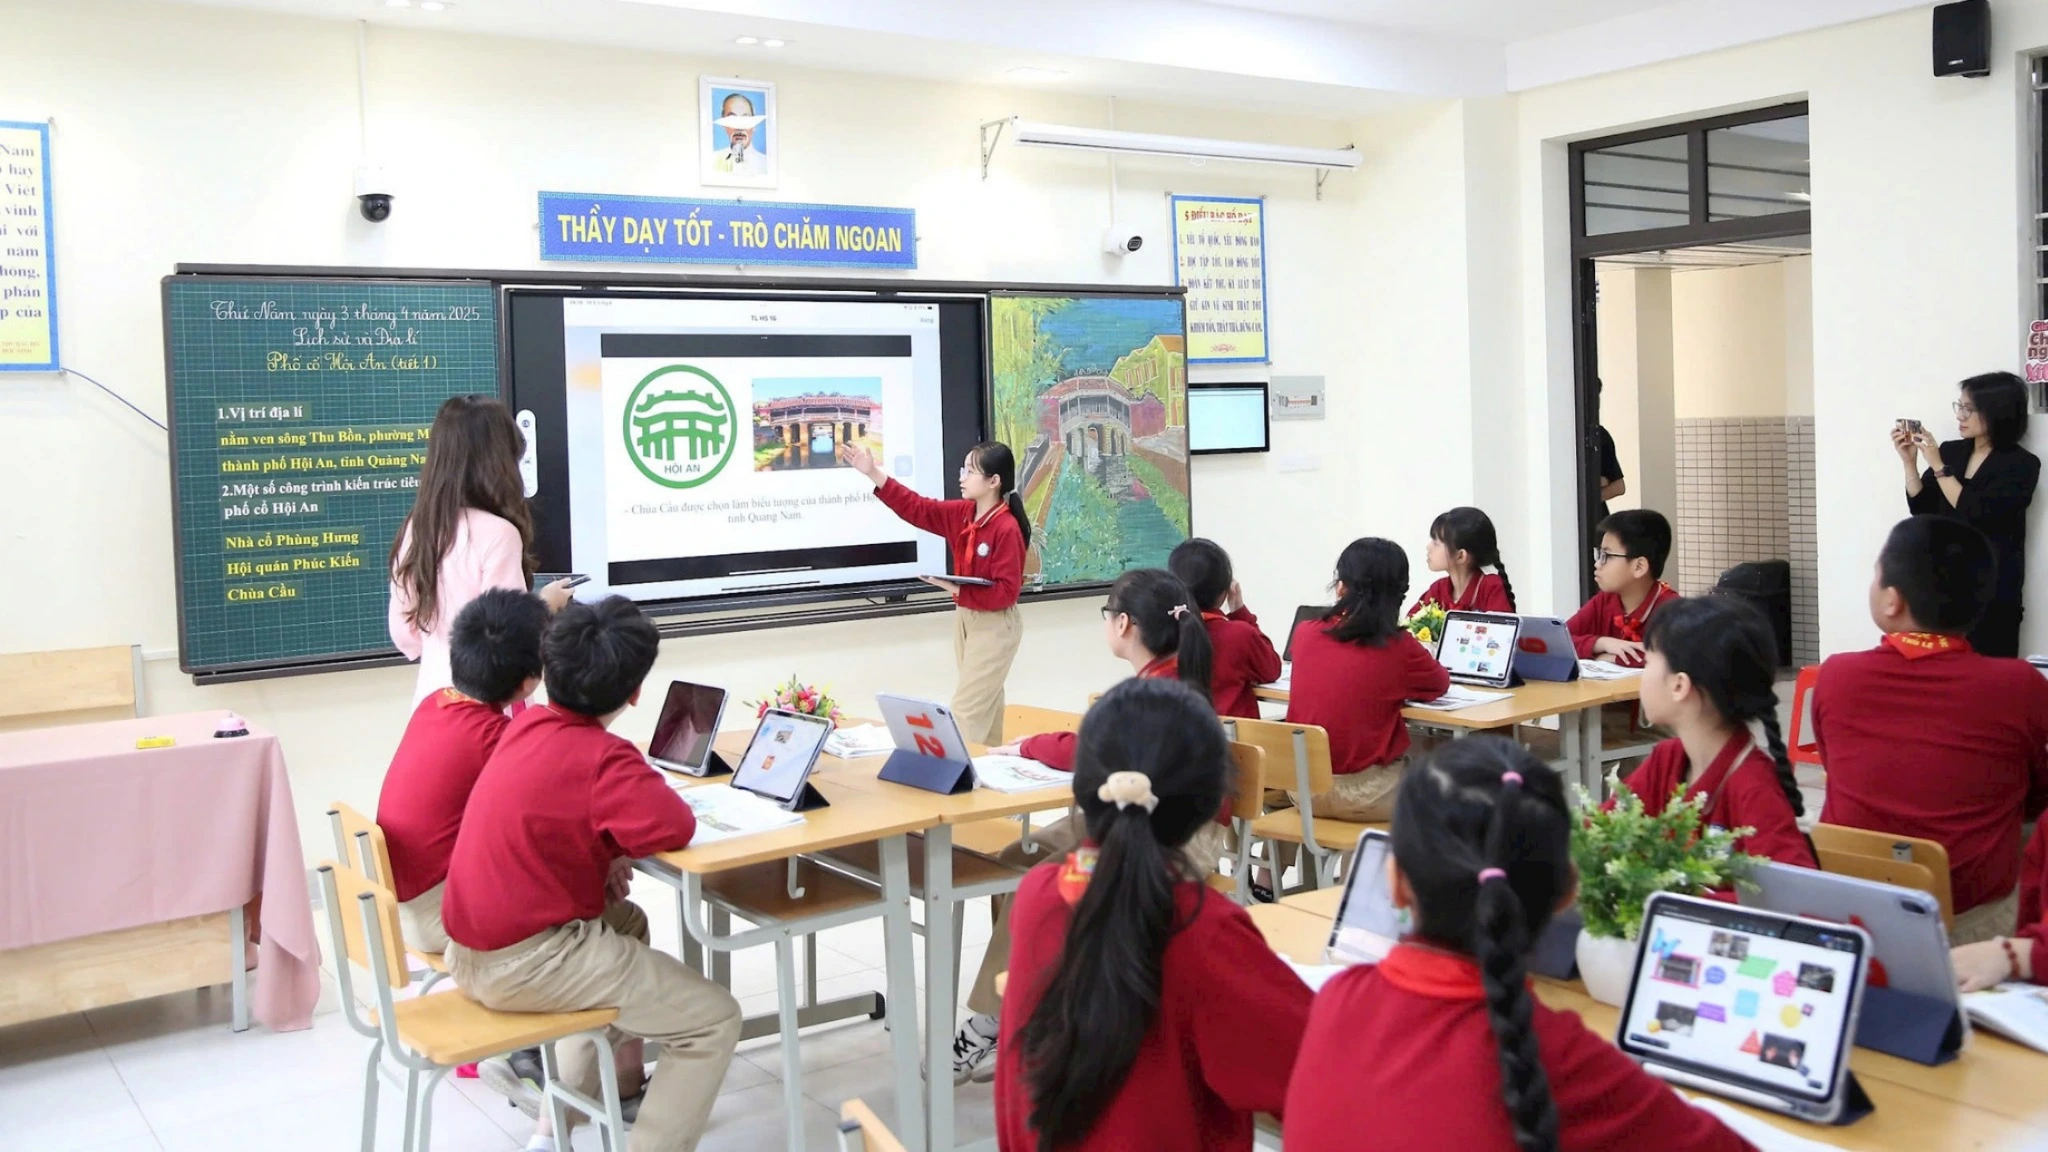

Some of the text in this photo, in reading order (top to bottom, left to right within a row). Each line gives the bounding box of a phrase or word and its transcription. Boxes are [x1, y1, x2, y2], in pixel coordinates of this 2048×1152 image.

[9, 163, 34, 179] hay
[5, 204, 37, 216] vinh
[17, 223, 38, 236] với
[557, 203, 902, 253] THẦY DẠY TỐT - TRÒ CHĂM NGOAN
[210, 299, 481, 329] Thứ Năm ngày 3 tháng 4 năm 2025
[293, 327, 329, 348] Lịch
[355, 331, 373, 346] và
[374, 327, 404, 348] Địa
[405, 327, 420, 346] lí
[266, 351, 438, 373] Phố cổ Hội An (tiết 1)
[217, 404, 304, 421] 1.Vị trí địa lí
[220, 427, 431, 447] nằm ven sông Thu Bồn, phường M
[222, 452, 426, 474] thành phố Hội An, tỉnh Quảng Na
[686, 463, 701, 473] AN
[221, 481, 260, 499] 2.Một
[262, 480, 276, 495] số
[279, 479, 308, 497] công
[311, 477, 342, 493] trình
[345, 475, 370, 490] kiến
[373, 475, 398, 489] trúc
[224, 500, 319, 520] phố cổ Hội An
[225, 531, 360, 549] Nhà cổ Phùng Hưng
[227, 551, 361, 577] Hội quán Phúc Kiến
[227, 581, 296, 602] Chùa Cầu
[904, 712, 947, 760] 12
